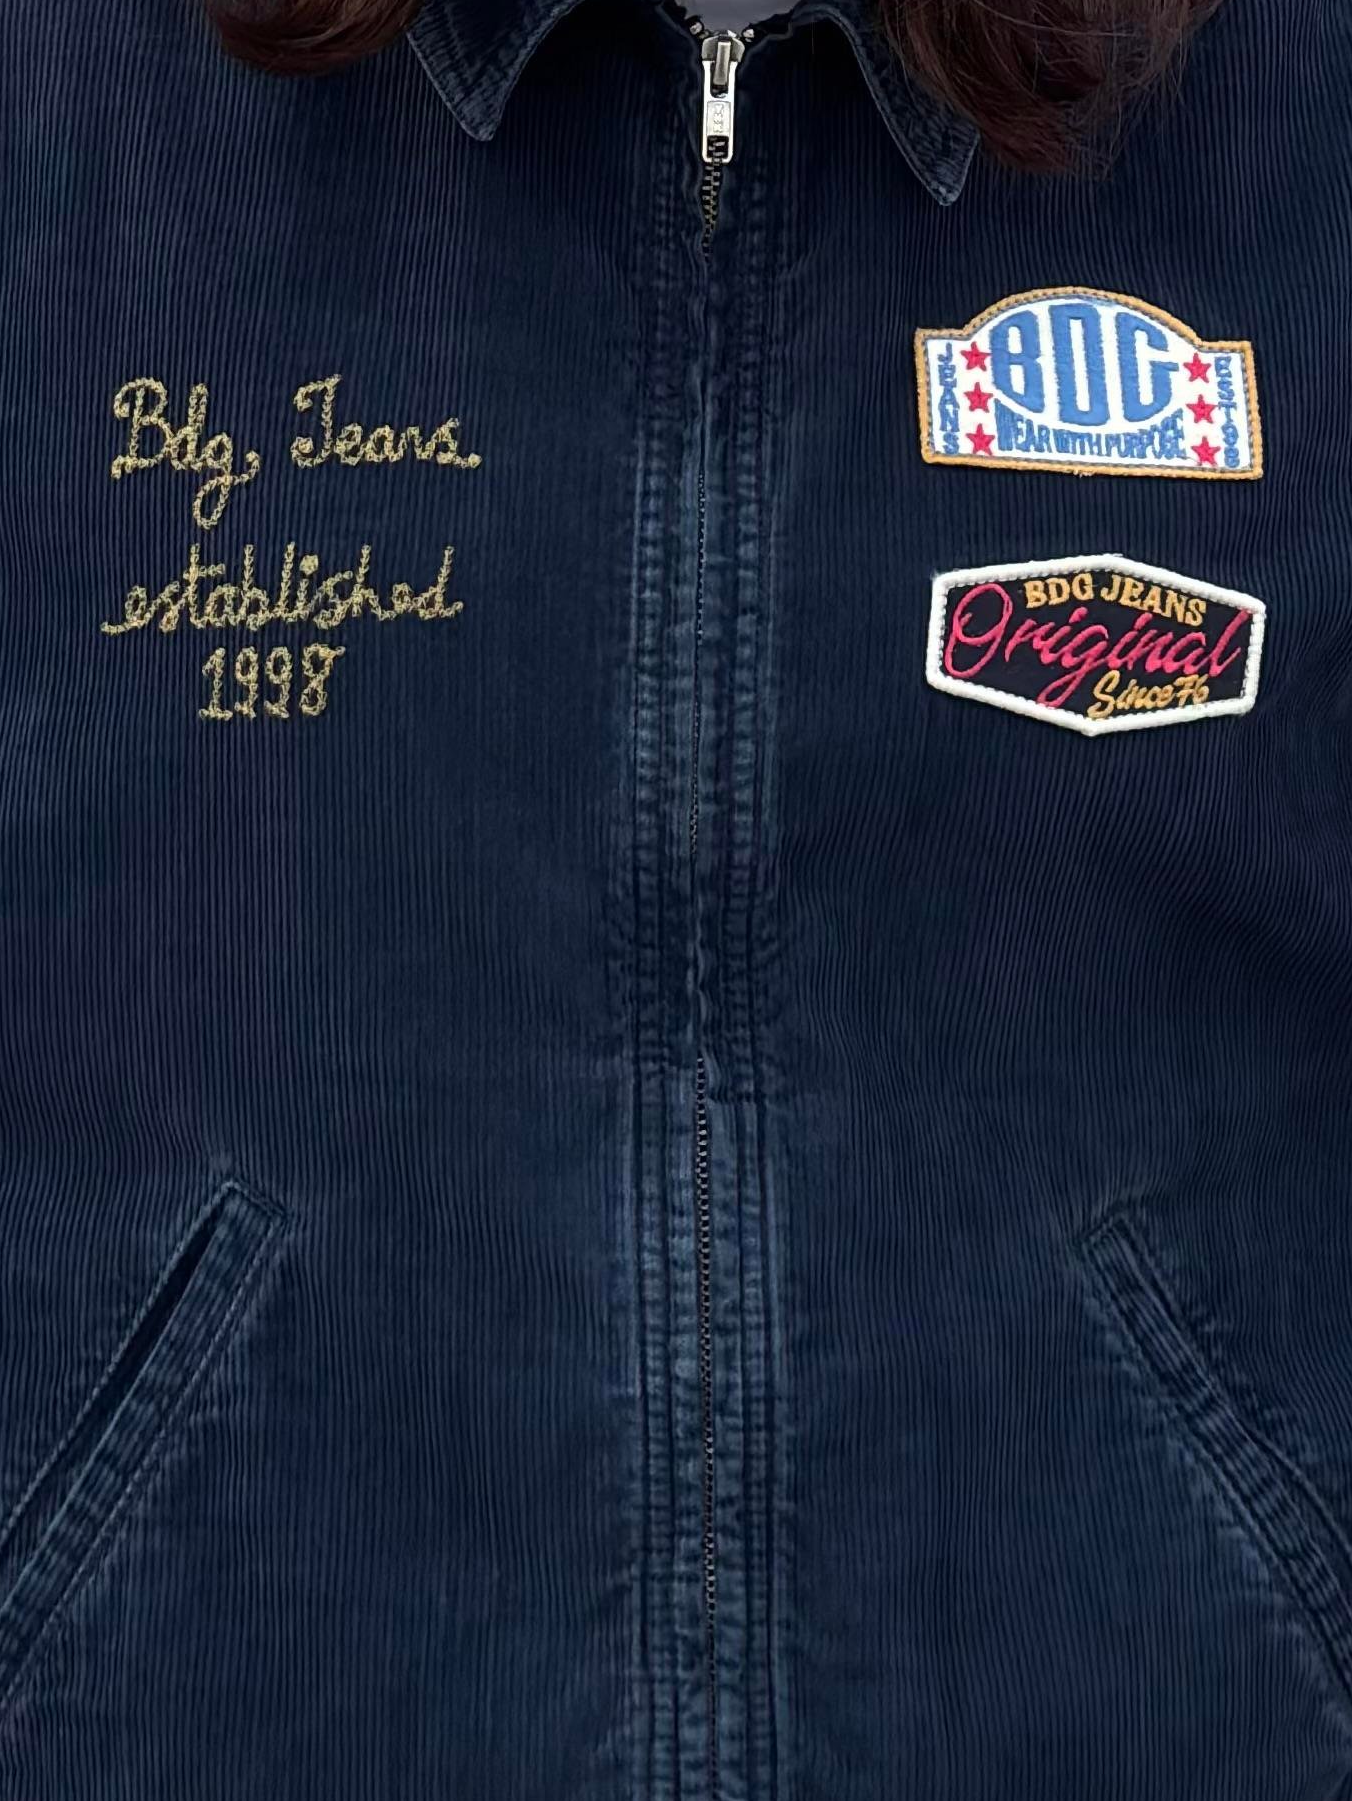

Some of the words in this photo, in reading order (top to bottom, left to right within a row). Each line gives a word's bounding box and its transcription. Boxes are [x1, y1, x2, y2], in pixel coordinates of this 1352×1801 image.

[937, 343, 960, 455] JEANS
[989, 303, 1179, 426] BDG
[100, 541, 464, 635] established
[1023, 572, 1095, 609] BDG
[1100, 574, 1207, 626] JEANS
[199, 643, 346, 720] 1998
[944, 583, 1252, 708] Original
